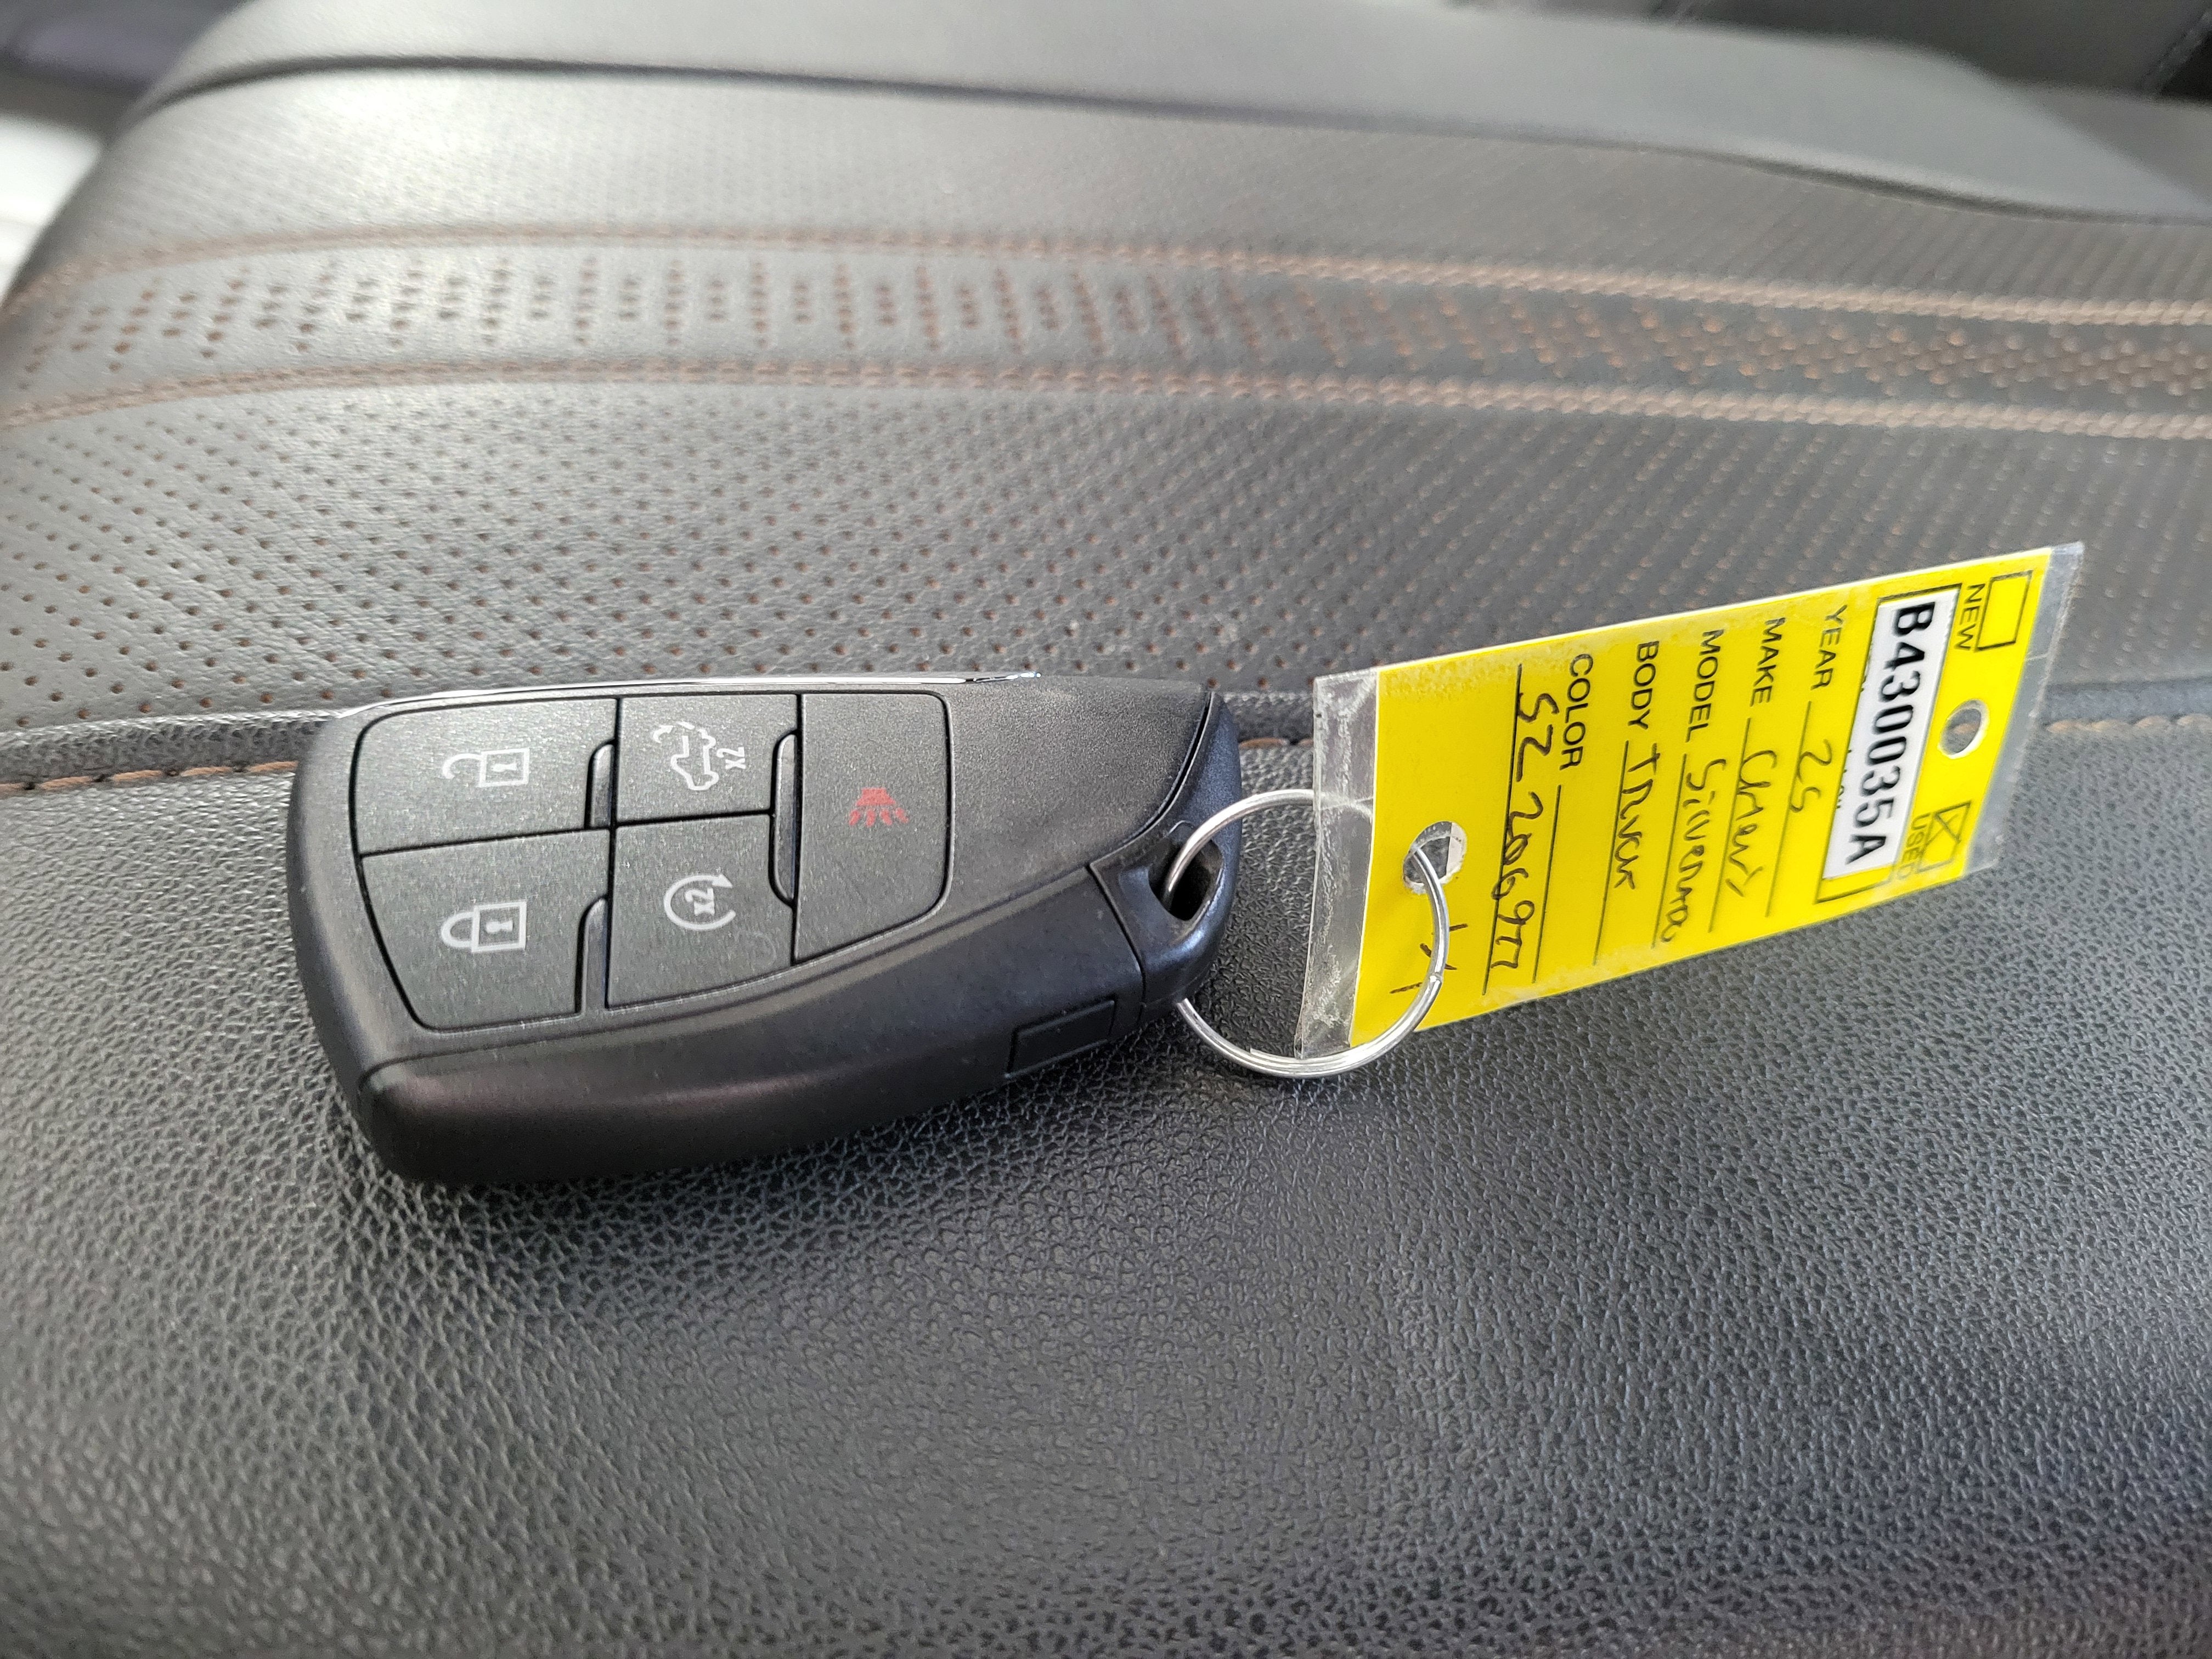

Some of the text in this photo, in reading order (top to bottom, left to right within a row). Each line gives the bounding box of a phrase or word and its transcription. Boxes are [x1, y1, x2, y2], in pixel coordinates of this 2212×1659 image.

[1750, 617, 1786, 707] MAKE
[1810, 604, 1848, 691] YEAR
[1954, 583, 1986, 652] NEW
[1559, 653, 1594, 771] COLOR
[1628, 640, 1660, 730] BODY
[1685, 629, 1725, 743] MODEL
[1789, 738, 1833, 813] 25
[1846, 601, 1936, 865] B430035A
[1898, 812, 1932, 879] USED
